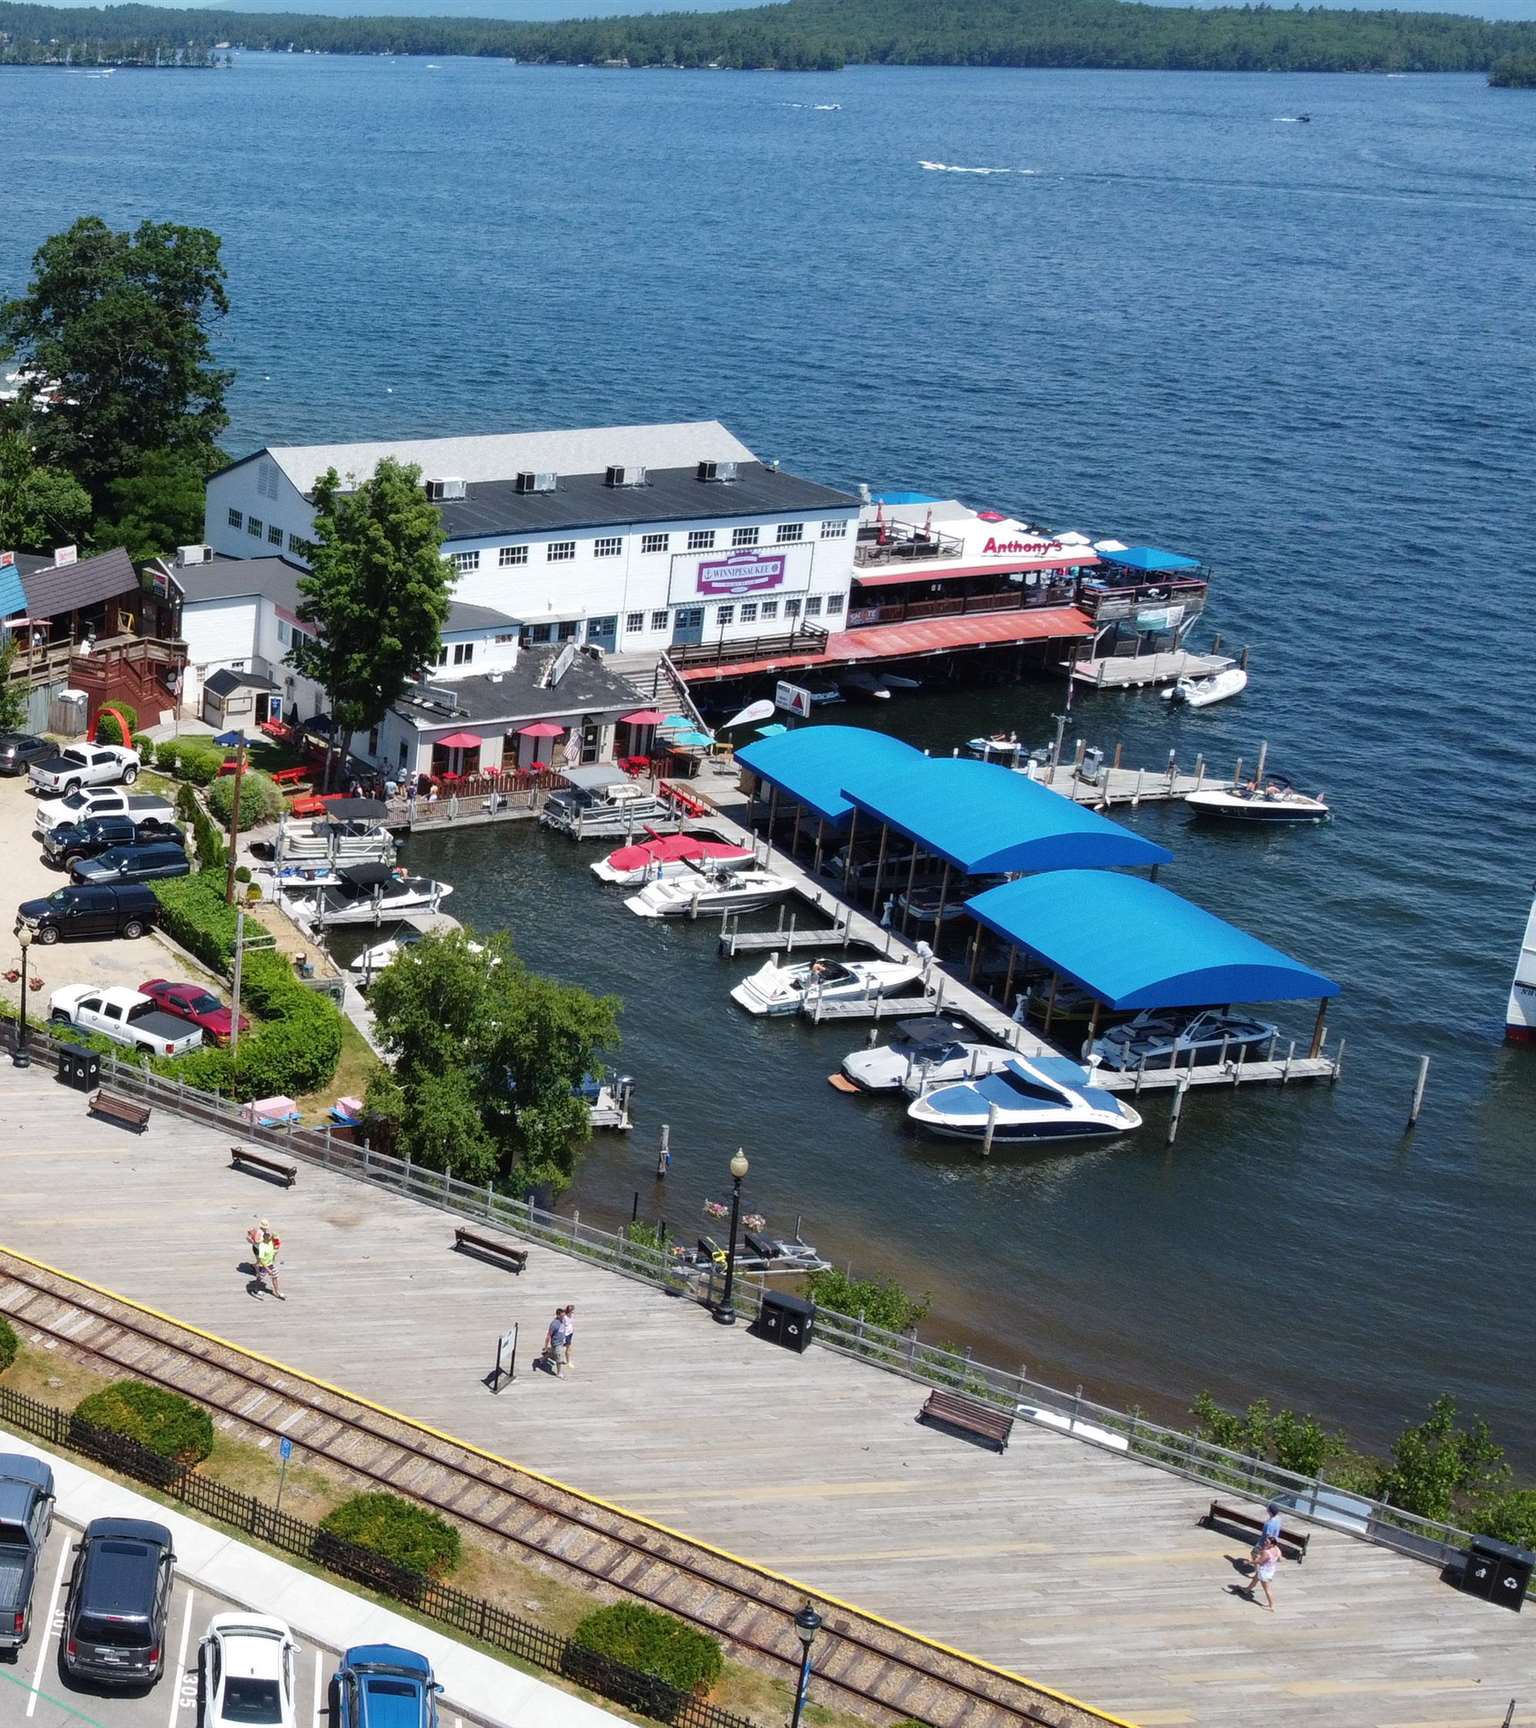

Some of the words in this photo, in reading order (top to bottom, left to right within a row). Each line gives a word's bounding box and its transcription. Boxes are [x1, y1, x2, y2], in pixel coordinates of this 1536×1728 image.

[982, 537, 1063, 555] Anthony's
[713, 564, 769, 578] WINNIPESAUKEE
[180, 1674, 198, 1708] 305
